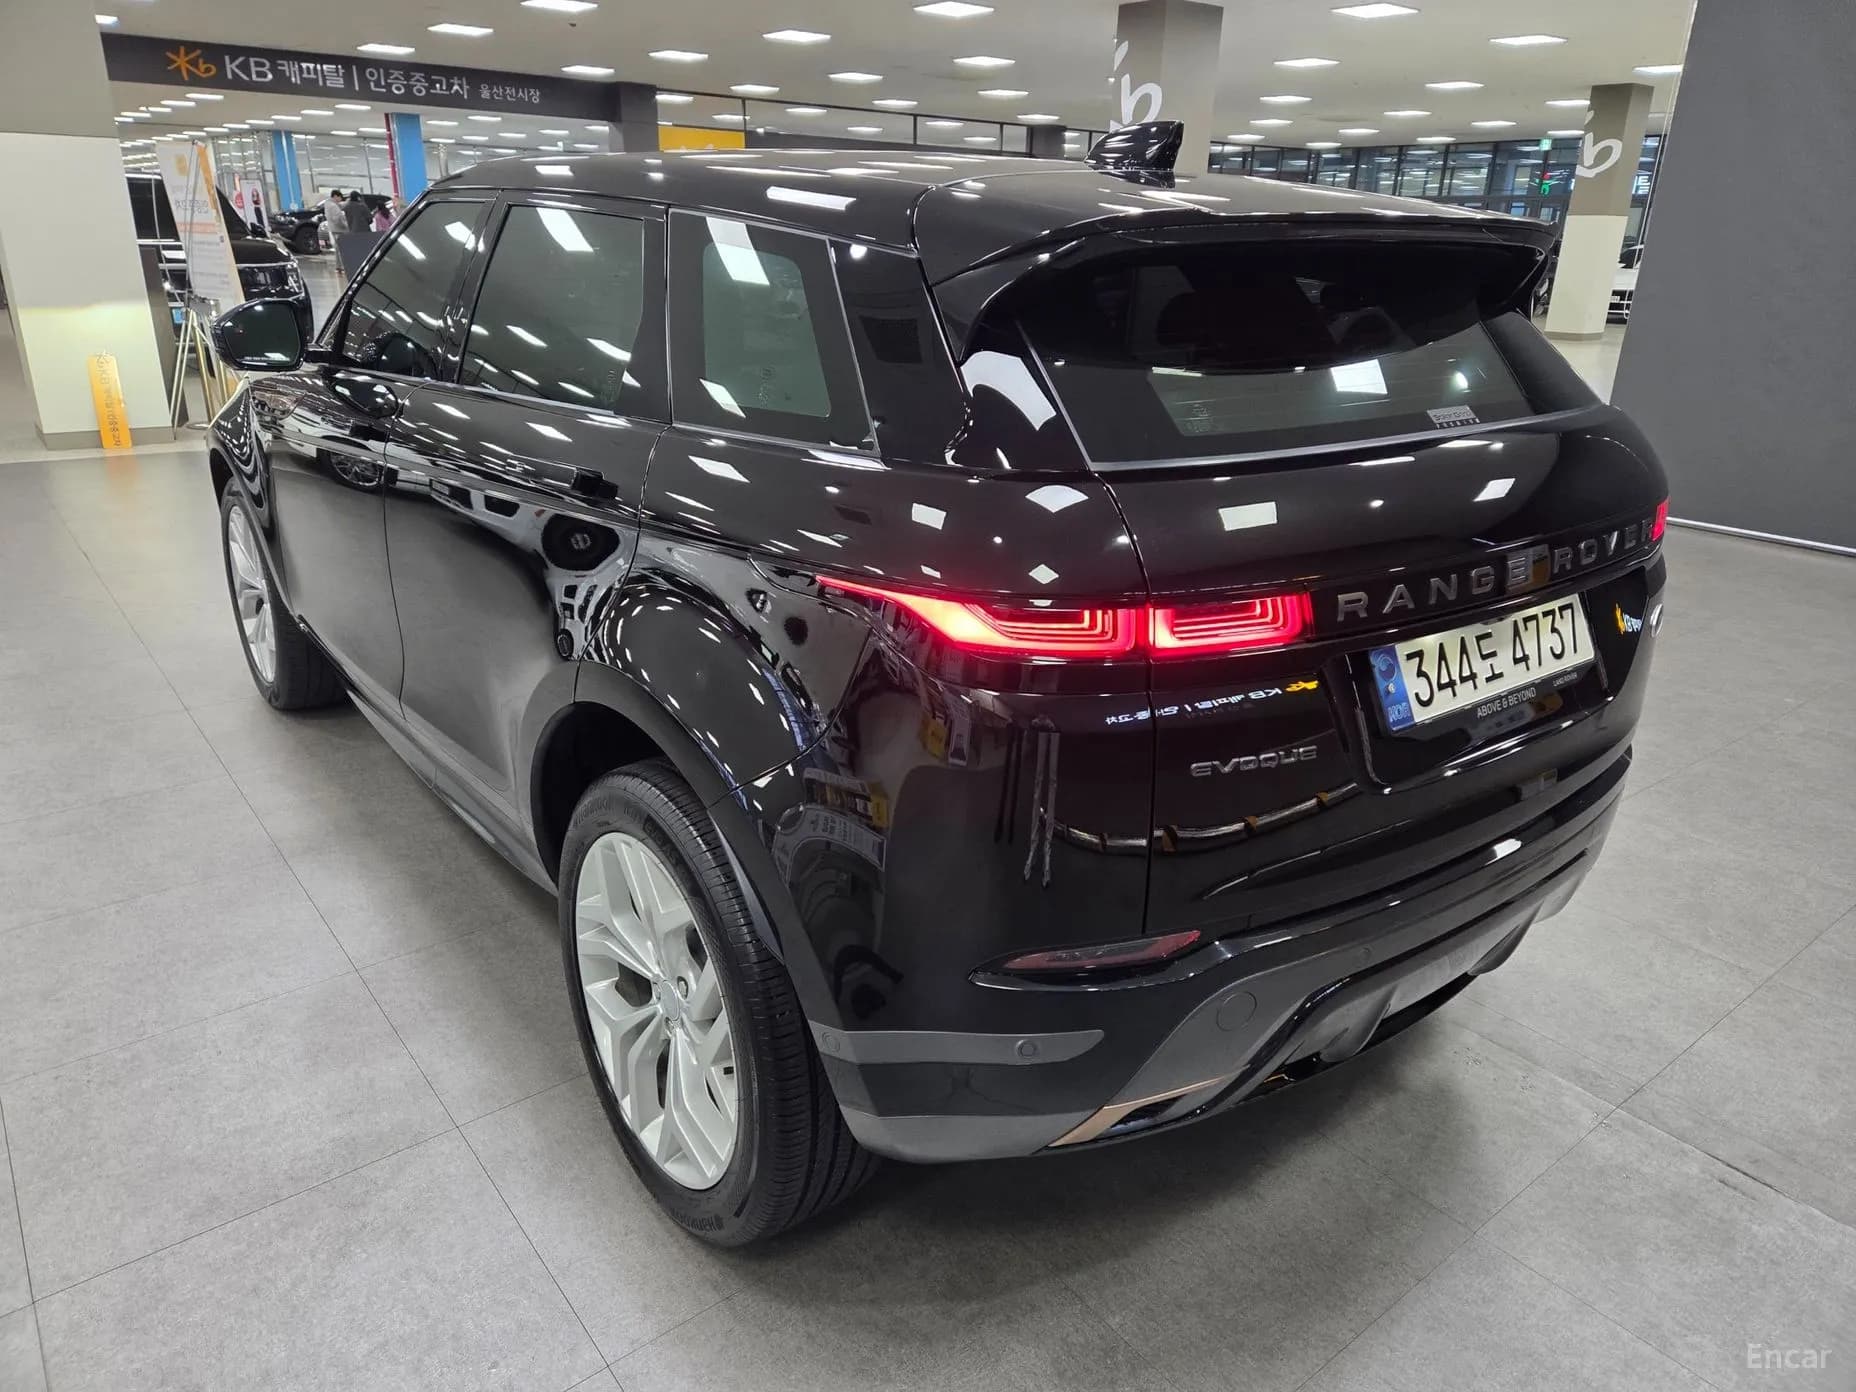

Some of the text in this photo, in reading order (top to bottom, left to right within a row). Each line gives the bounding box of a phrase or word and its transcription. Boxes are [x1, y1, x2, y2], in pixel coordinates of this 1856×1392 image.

[224, 55, 273, 82] KB
[276, 59, 345, 88] 캐피탈
[365, 67, 471, 100] 인증중고차
[479, 83, 541, 104] 울산전시장
[1337, 556, 1530, 622] RANGE
[1406, 603, 1578, 708] 344도 4737
[1477, 687, 1537, 719] ABOVE & BEYOND
[1190, 745, 1318, 777] EVOQUE
